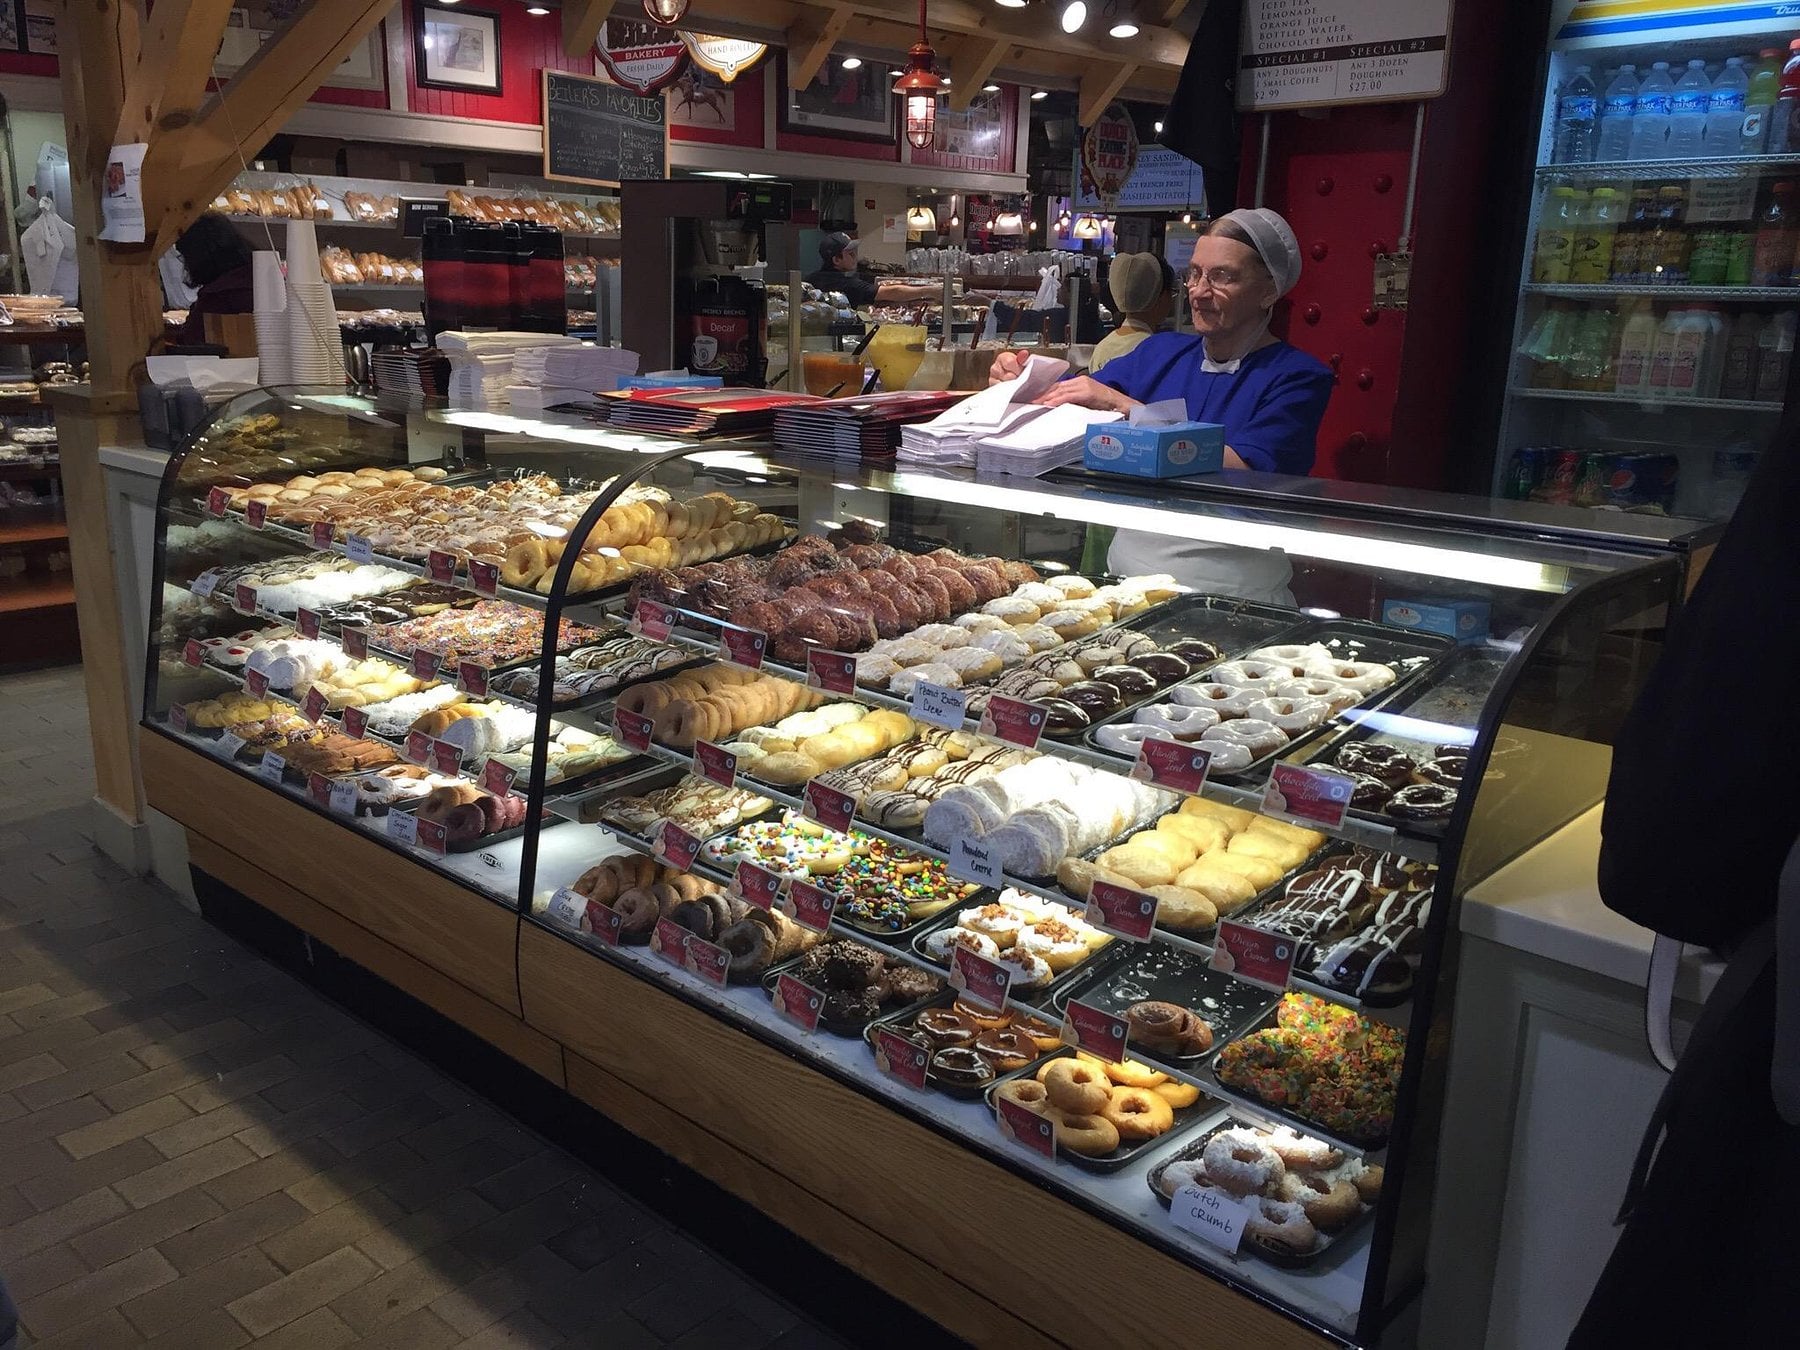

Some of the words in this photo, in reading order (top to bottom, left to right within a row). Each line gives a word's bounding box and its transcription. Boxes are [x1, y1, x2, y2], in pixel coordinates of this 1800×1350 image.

[1262, 1, 1286, 10] ICED
[1261, 7, 1316, 20] LEMONADE
[1260, 19, 1301, 30] ORANGE
[1308, 15, 1336, 26] JUICE
[1259, 29, 1305, 40] BOTTLED
[1311, 25, 1346, 34] WATER
[1258, 37, 1319, 49] CHOCOLATE
[1326, 34, 1354, 43] MILK
[626, 49, 666, 60] BAKERY
[708, 46, 728, 54] HAND
[1350, 44, 1403, 57] SPECIAL
[1410, 40, 1426, 50] #2
[1257, 53, 1307, 66] SPECIAL
[1313, 51, 1326, 60] #1
[1351, 62, 1368, 70] ANY
[1379, 58, 1408, 68] DOZEN
[647, 62, 665, 71] DAILY
[1257, 71, 1271, 79] ANY
[1283, 65, 1333, 76] DOUGHNUTS
[1290, 76, 1320, 86] COFFEE
[1350, 69, 1404, 80] DOUGHNUTS
[1349, 80, 1382, 92] $27.00
[607, 86, 662, 123] FAVORITES
[711, 323, 735, 332] Decaf
[918, 684, 940, 698] Peanut
[941, 692, 963, 707] Butter
[1151, 745, 1178, 762] Vanilla
[1165, 762, 1185, 773] Iced
[1279, 772, 1322, 791] Chocolate
[1183, 1188, 1220, 1210] Dutch
